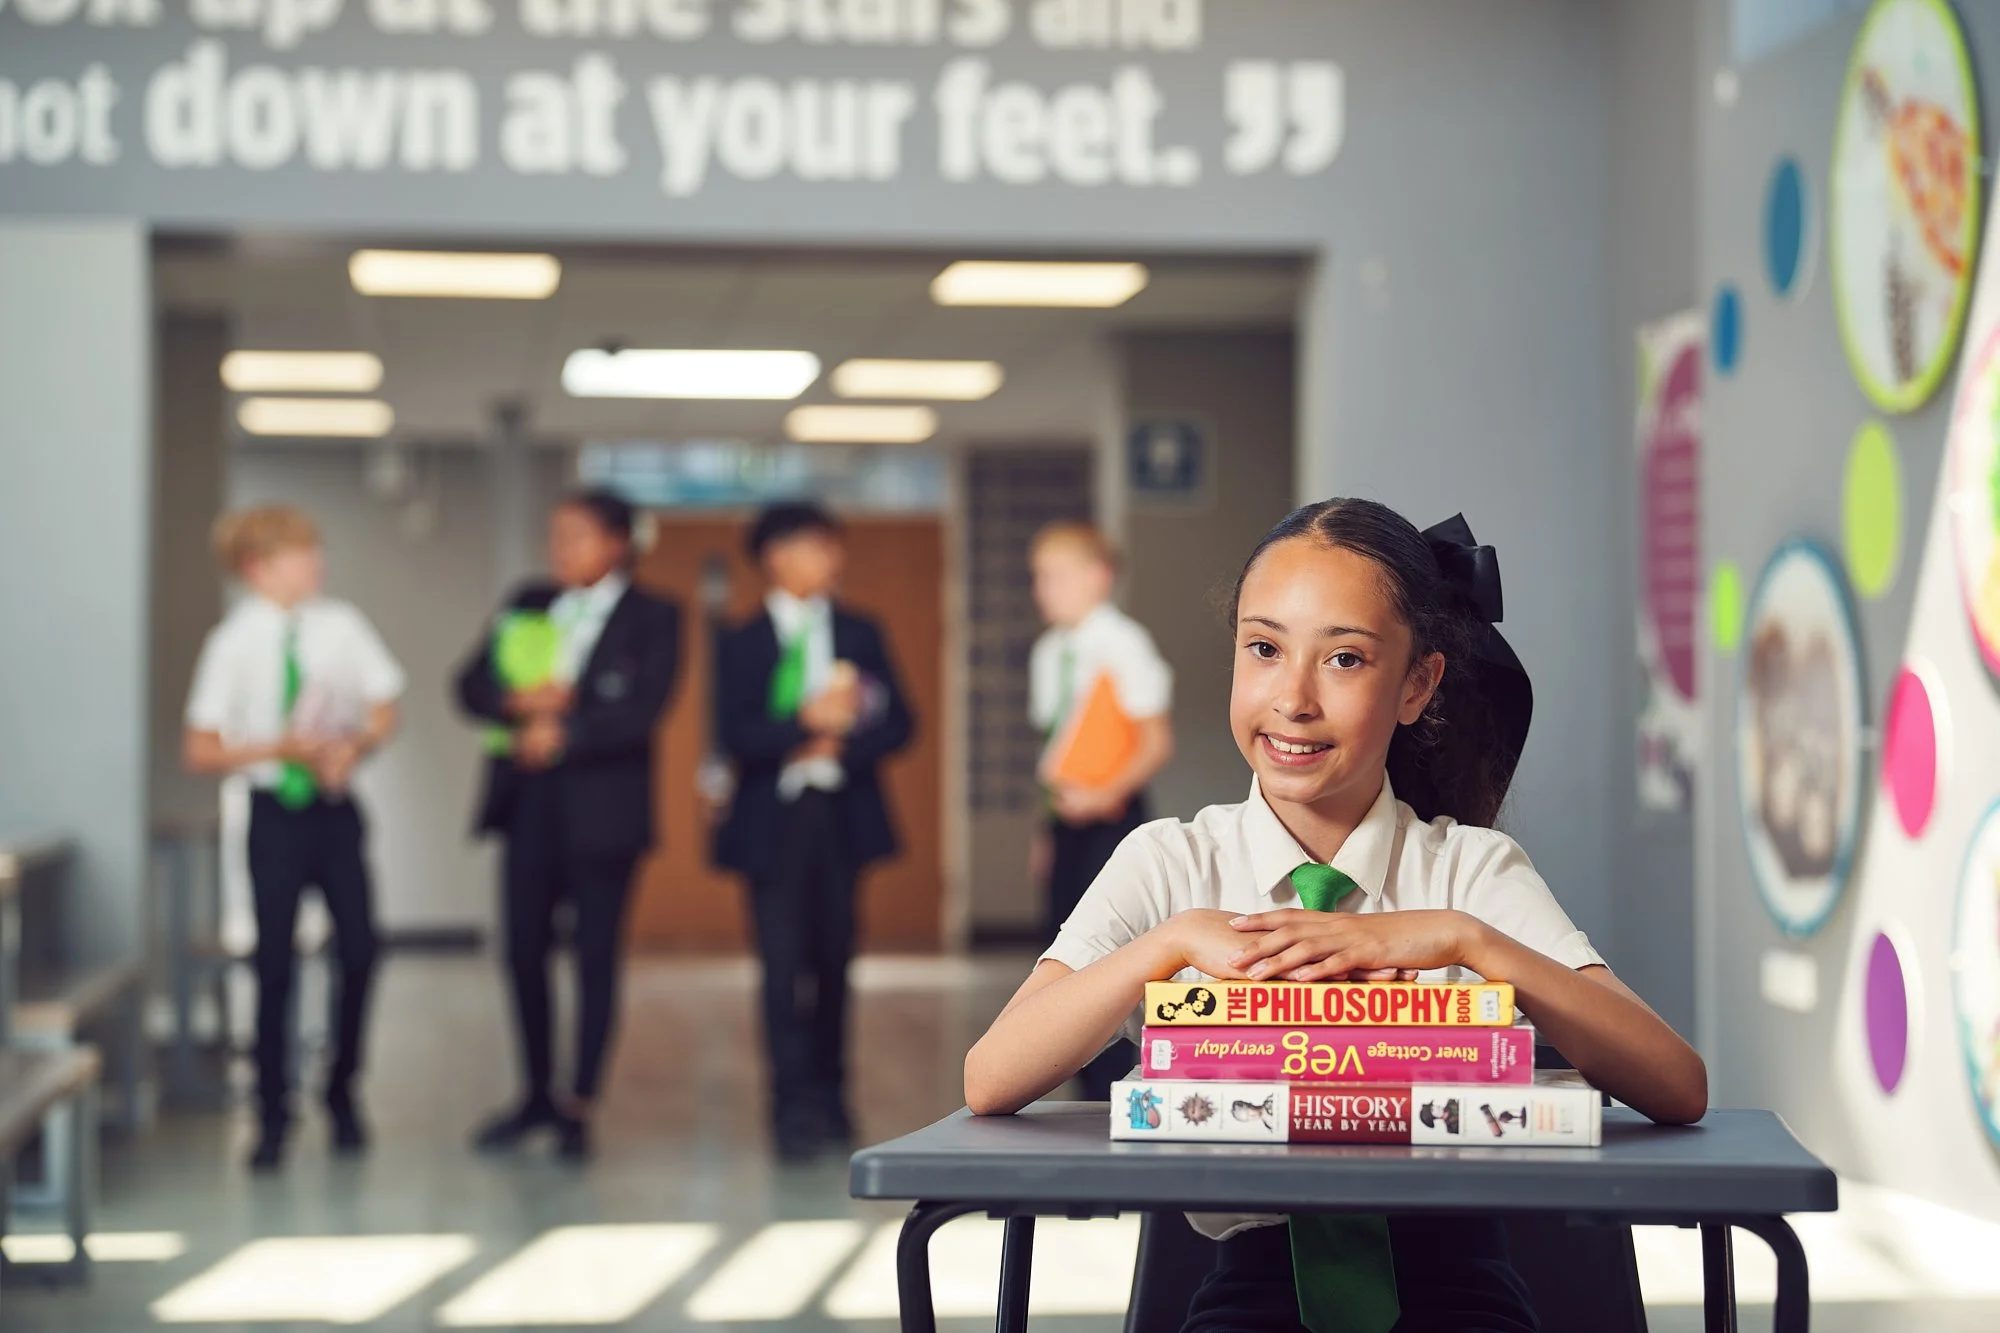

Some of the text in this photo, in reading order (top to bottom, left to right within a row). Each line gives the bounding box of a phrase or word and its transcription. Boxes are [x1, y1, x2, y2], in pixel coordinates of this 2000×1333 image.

[145, 40, 480, 170] down
[499, 52, 628, 175] at
[648, 74, 917, 197] your
[934, 56, 1202, 186] feet.
[1227, 987, 1471, 1023] THE PHILOSOPHY BOOK
[1194, 1031, 1478, 1076] River Cottage veg every day!
[1508, 1045, 1517, 1066] Hugh
[1293, 1095, 1408, 1119] HISTORY
[1293, 1118, 1407, 1132] YEAR BY YEAR
